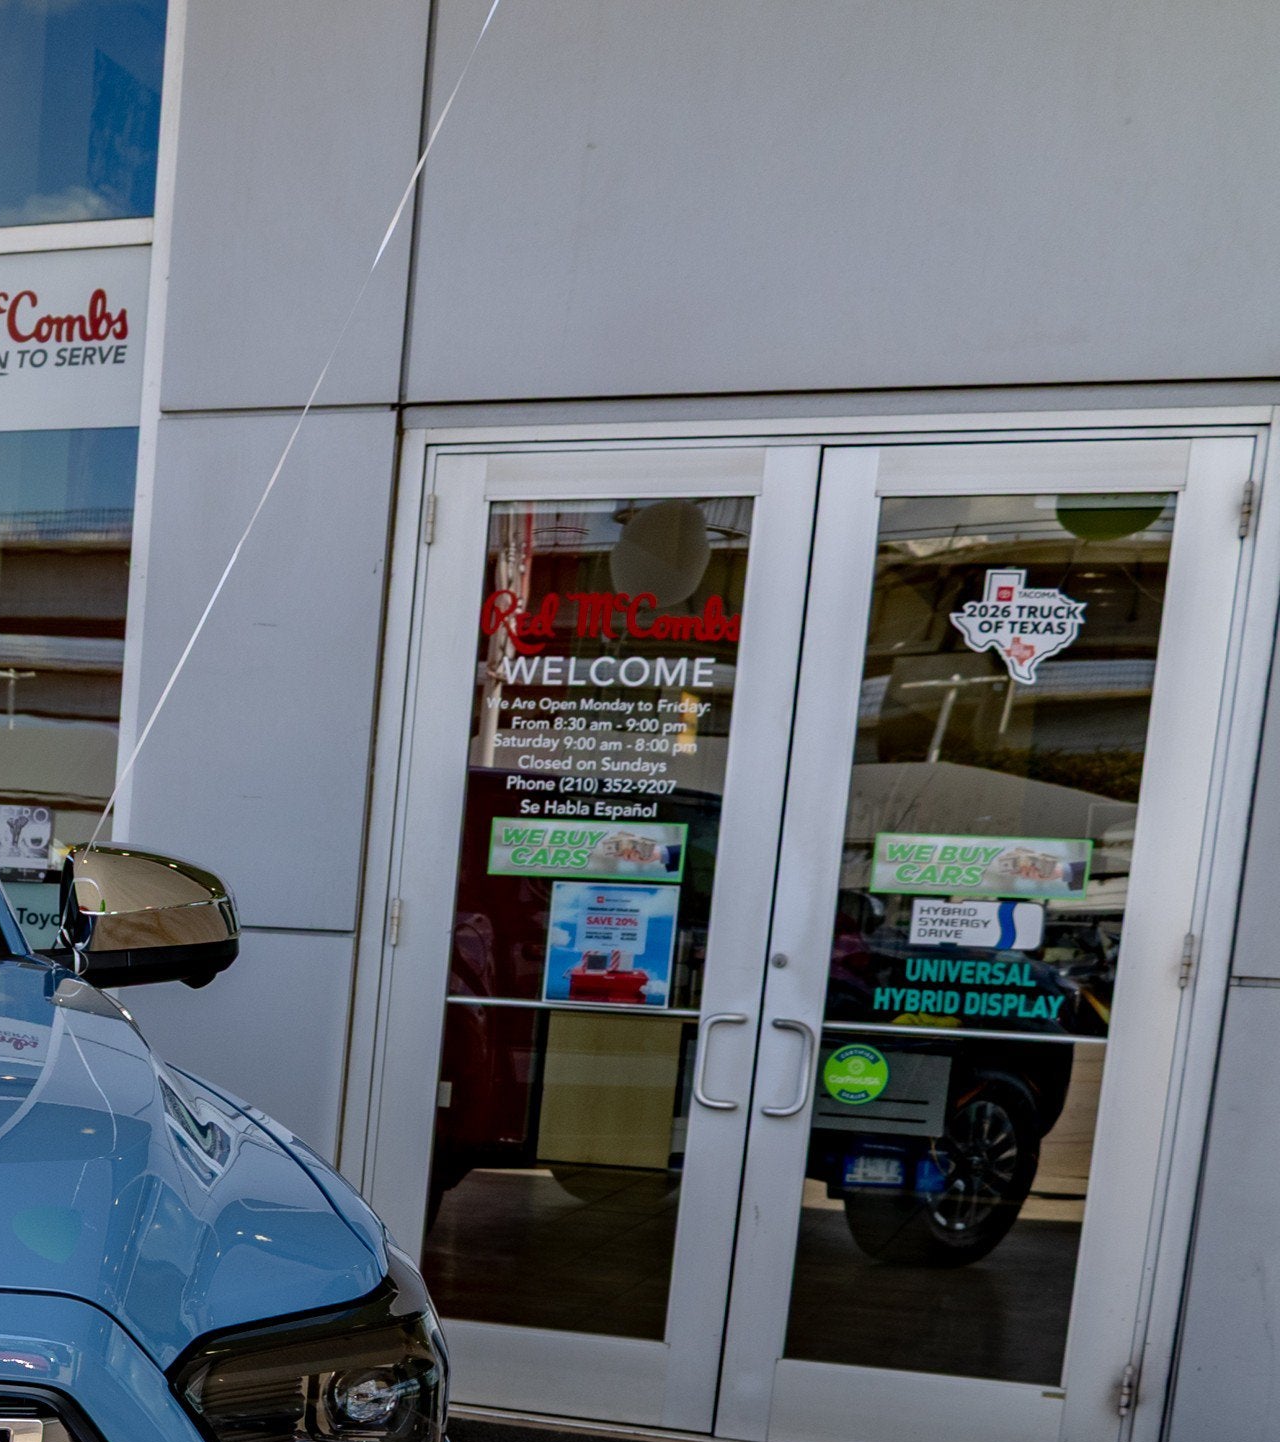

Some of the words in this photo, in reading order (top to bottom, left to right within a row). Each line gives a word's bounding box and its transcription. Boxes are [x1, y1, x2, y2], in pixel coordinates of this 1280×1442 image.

[18, 349, 48, 368] TO
[55, 345, 126, 366] SERVE
[1017, 590, 1057, 599] TACOMA
[966, 604, 1011, 618] 2026
[1015, 605, 1079, 620] TRUCK
[481, 590, 557, 654] Red
[566, 592, 741, 642] McCombs
[978, 621, 1003, 633] OF
[1008, 621, 1066, 634] TEXAS
[502, 656, 715, 688] WELCOME
[486, 698, 508, 710] We
[510, 698, 536, 710] Are
[539, 699, 577, 714] Open
[580, 699, 634, 715] Monday
[638, 700, 653, 712] to
[657, 699, 711, 716] Friday:
[511, 718, 549, 731] From
[554, 718, 586, 731] 8:30
[589, 721, 612, 731] am
[625, 718, 660, 732] 9:00
[662, 721, 687, 736] pm
[492, 734, 559, 752] Saturday
[564, 736, 596, 751] 9:00
[600, 740, 622, 751] am
[635, 738, 669, 753] 8:00
[672, 741, 698, 756] pm
[518, 755, 571, 770] Closed
[576, 759, 596, 770] on
[601, 757, 667, 774] Sundays
[506, 776, 555, 791] Phone
[559, 777, 598, 794] (210)
[603, 778, 677, 795] 352-9207
[520, 800, 540, 814] Se
[544, 800, 590, 816] Habla
[594, 802, 657, 820] Español
[502, 827, 543, 846] WE
[544, 829, 605, 848] BUY
[510, 847, 591, 869] CARS
[887, 844, 937, 864] WE
[939, 846, 1004, 865] BUY
[895, 864, 985, 885] CARS
[919, 906, 977, 916] HYBRID
[586, 916, 613, 926] SAVE
[615, 917, 638, 927] 20%
[918, 918, 991, 928] SYNERGY
[917, 928, 964, 939] DRIVE
[905, 958, 1037, 987] UNIVERSAL
[874, 988, 959, 1014] HYBRID
[964, 991, 1066, 1019] DISPLAY
